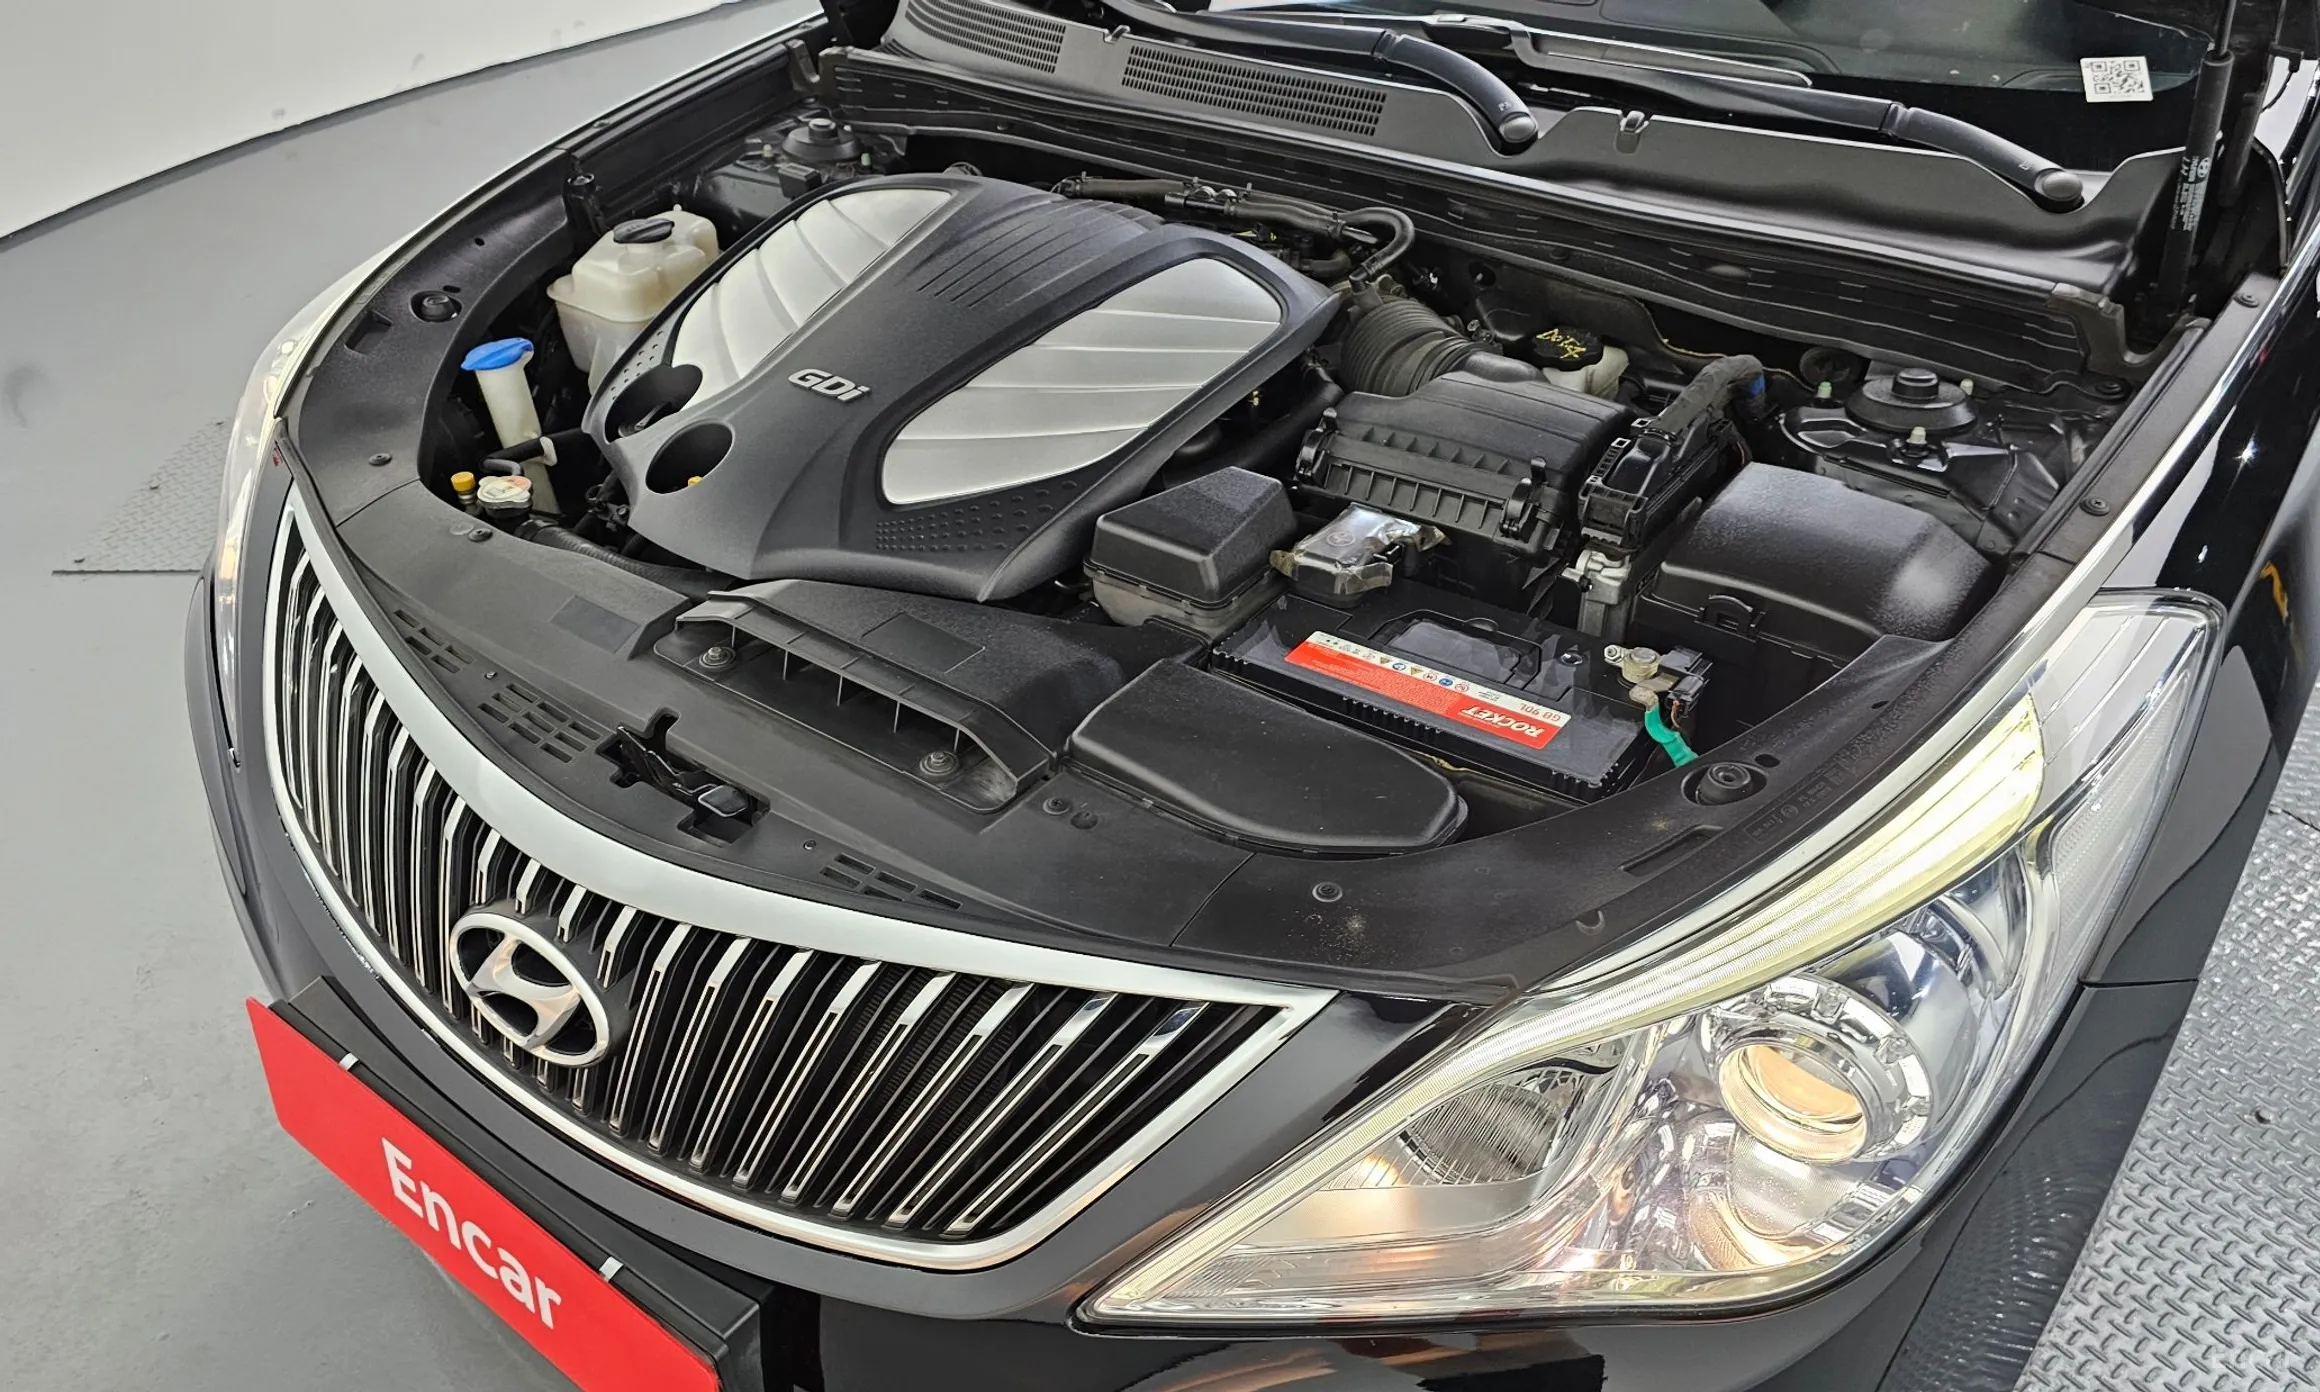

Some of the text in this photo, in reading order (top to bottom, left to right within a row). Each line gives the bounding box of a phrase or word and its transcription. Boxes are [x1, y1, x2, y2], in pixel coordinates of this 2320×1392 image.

[788, 369, 870, 401] GDi
[1461, 706, 1545, 738] ROCKET
[1520, 703, 1561, 722] GB 90L
[382, 1137, 562, 1330] Encar
